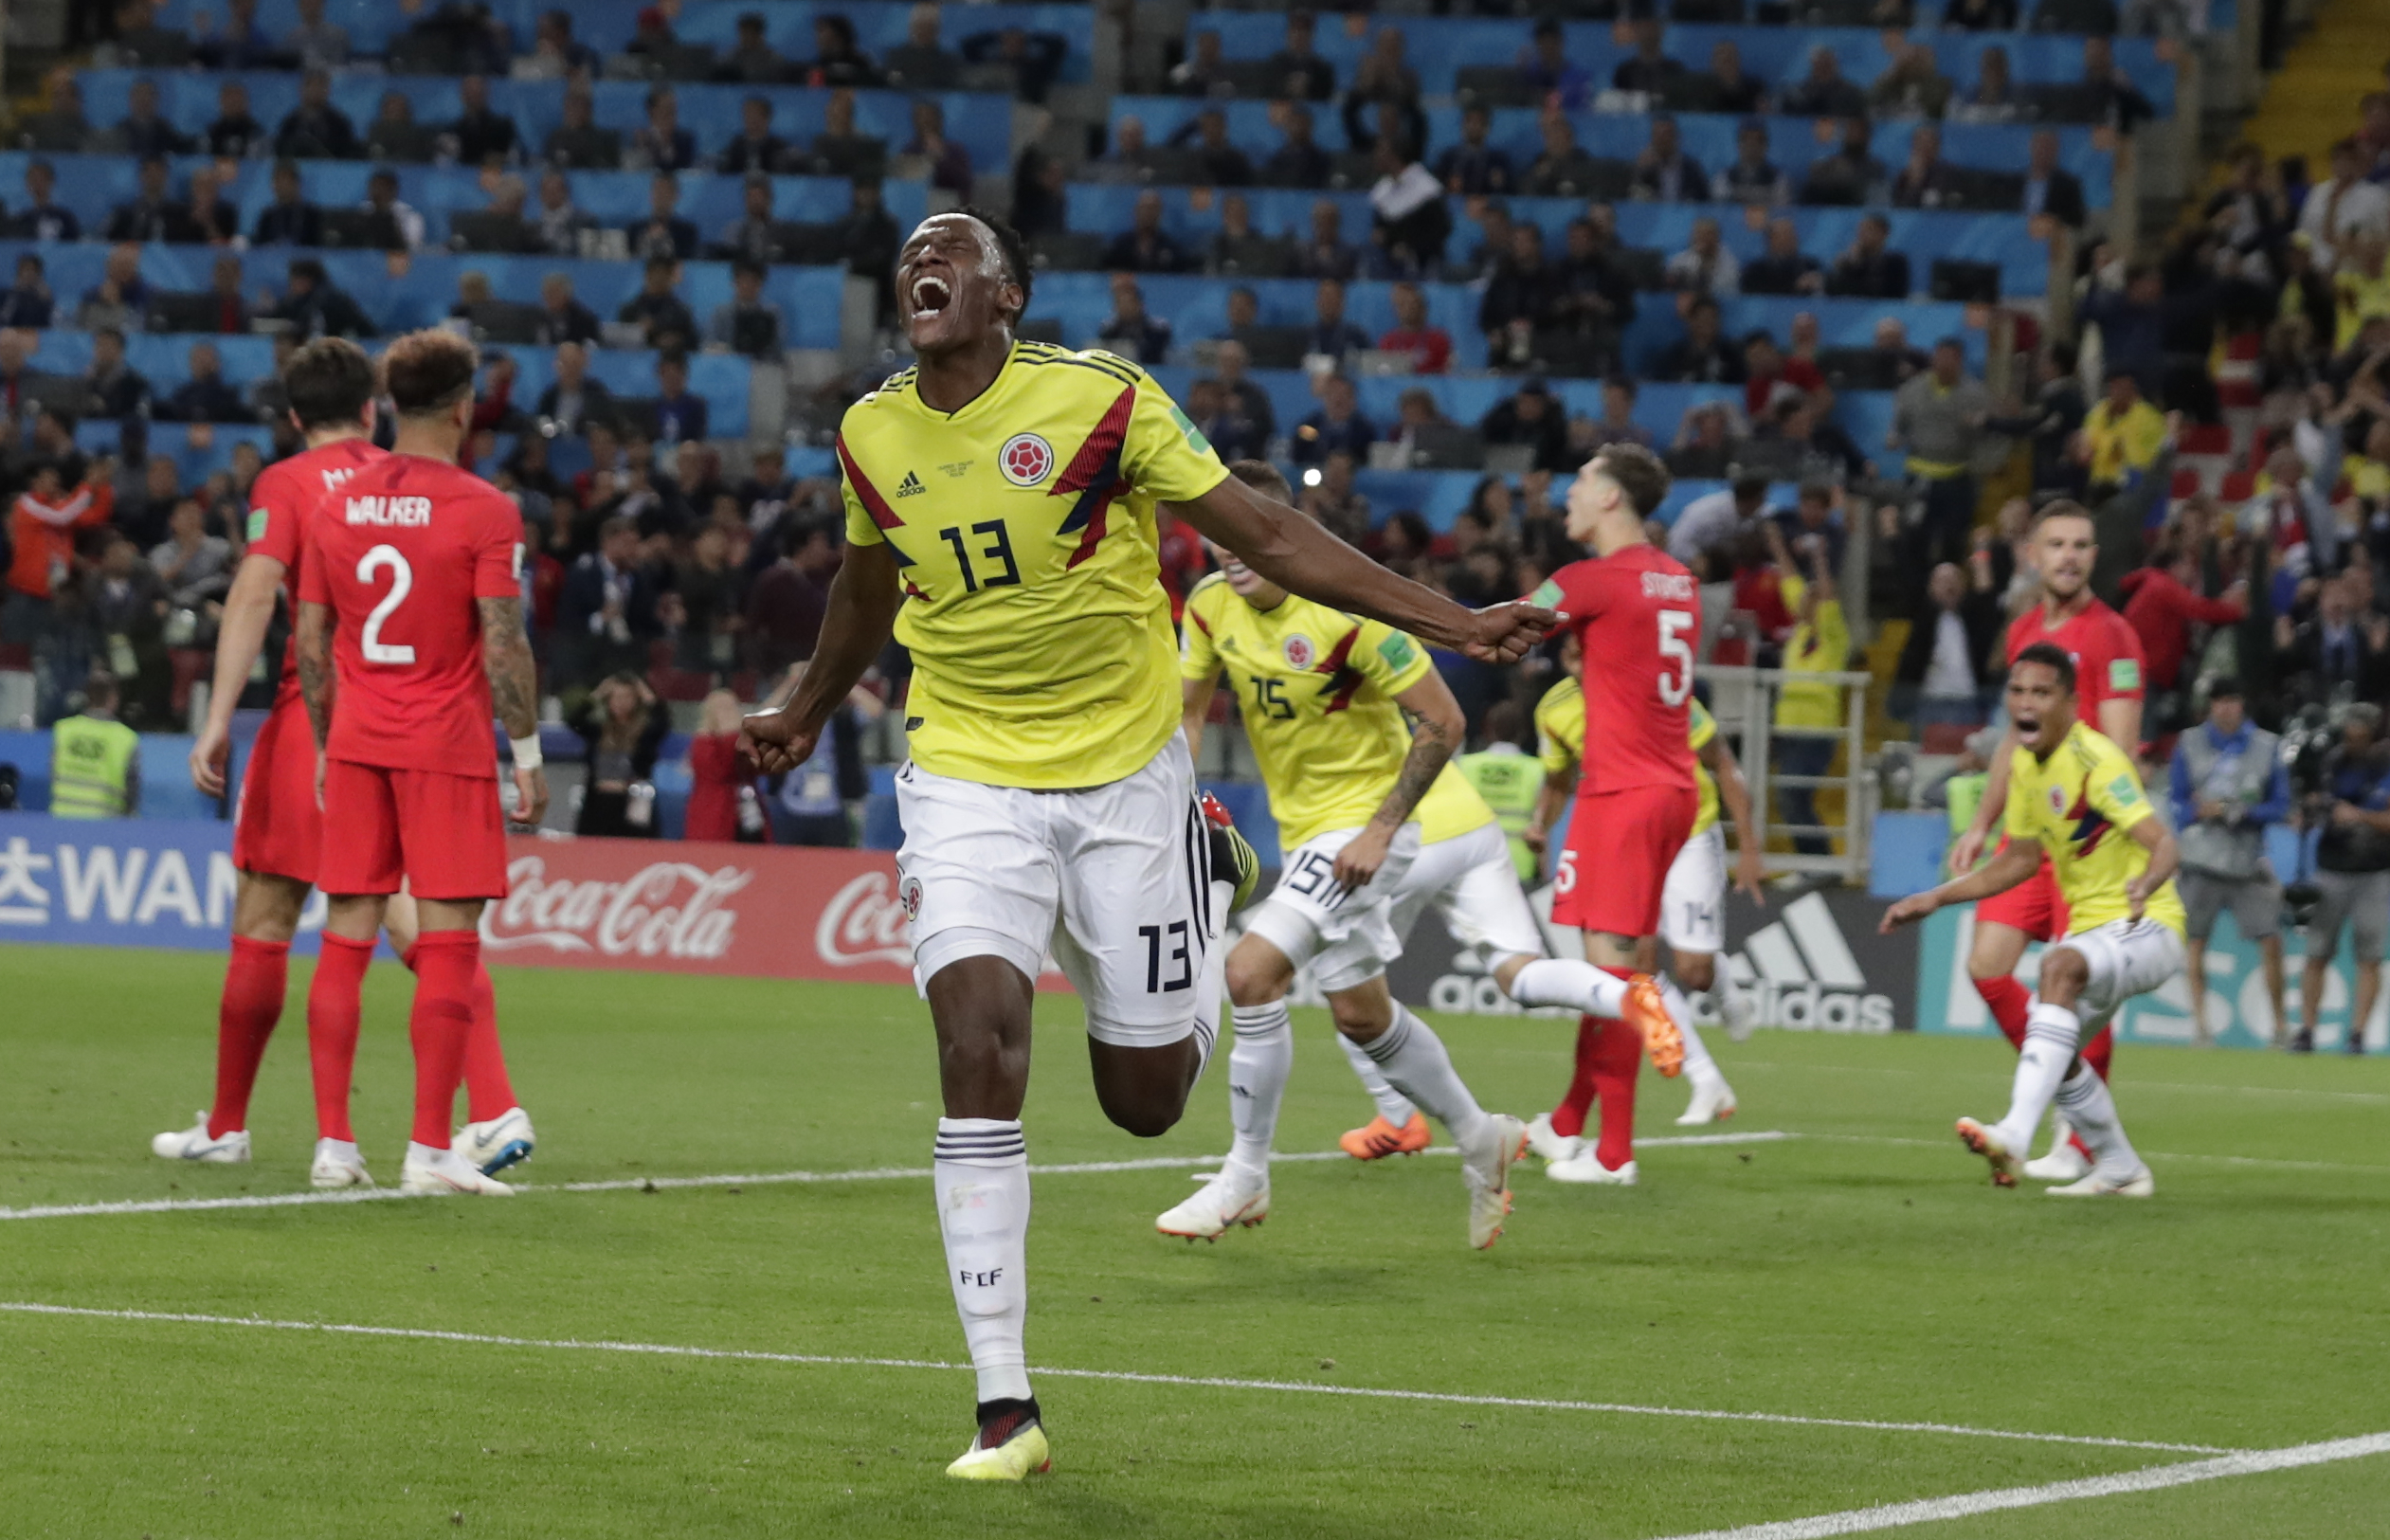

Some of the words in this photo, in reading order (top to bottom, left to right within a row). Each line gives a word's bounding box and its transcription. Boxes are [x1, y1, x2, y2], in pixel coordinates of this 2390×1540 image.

[345, 496, 432, 528] WALKER
[896, 484, 927, 498] adidas
[939, 518, 1022, 593] 13
[355, 544, 416, 664] 2
[1657, 608, 1694, 707] 5
[1250, 676, 1297, 720] 15
[1281, 850, 1334, 896] 15
[1556, 848, 1579, 895] 5
[477, 855, 754, 958] Coca-Cola
[1138, 919, 1192, 994] 13
[960, 1267, 1004, 1287] FCF
